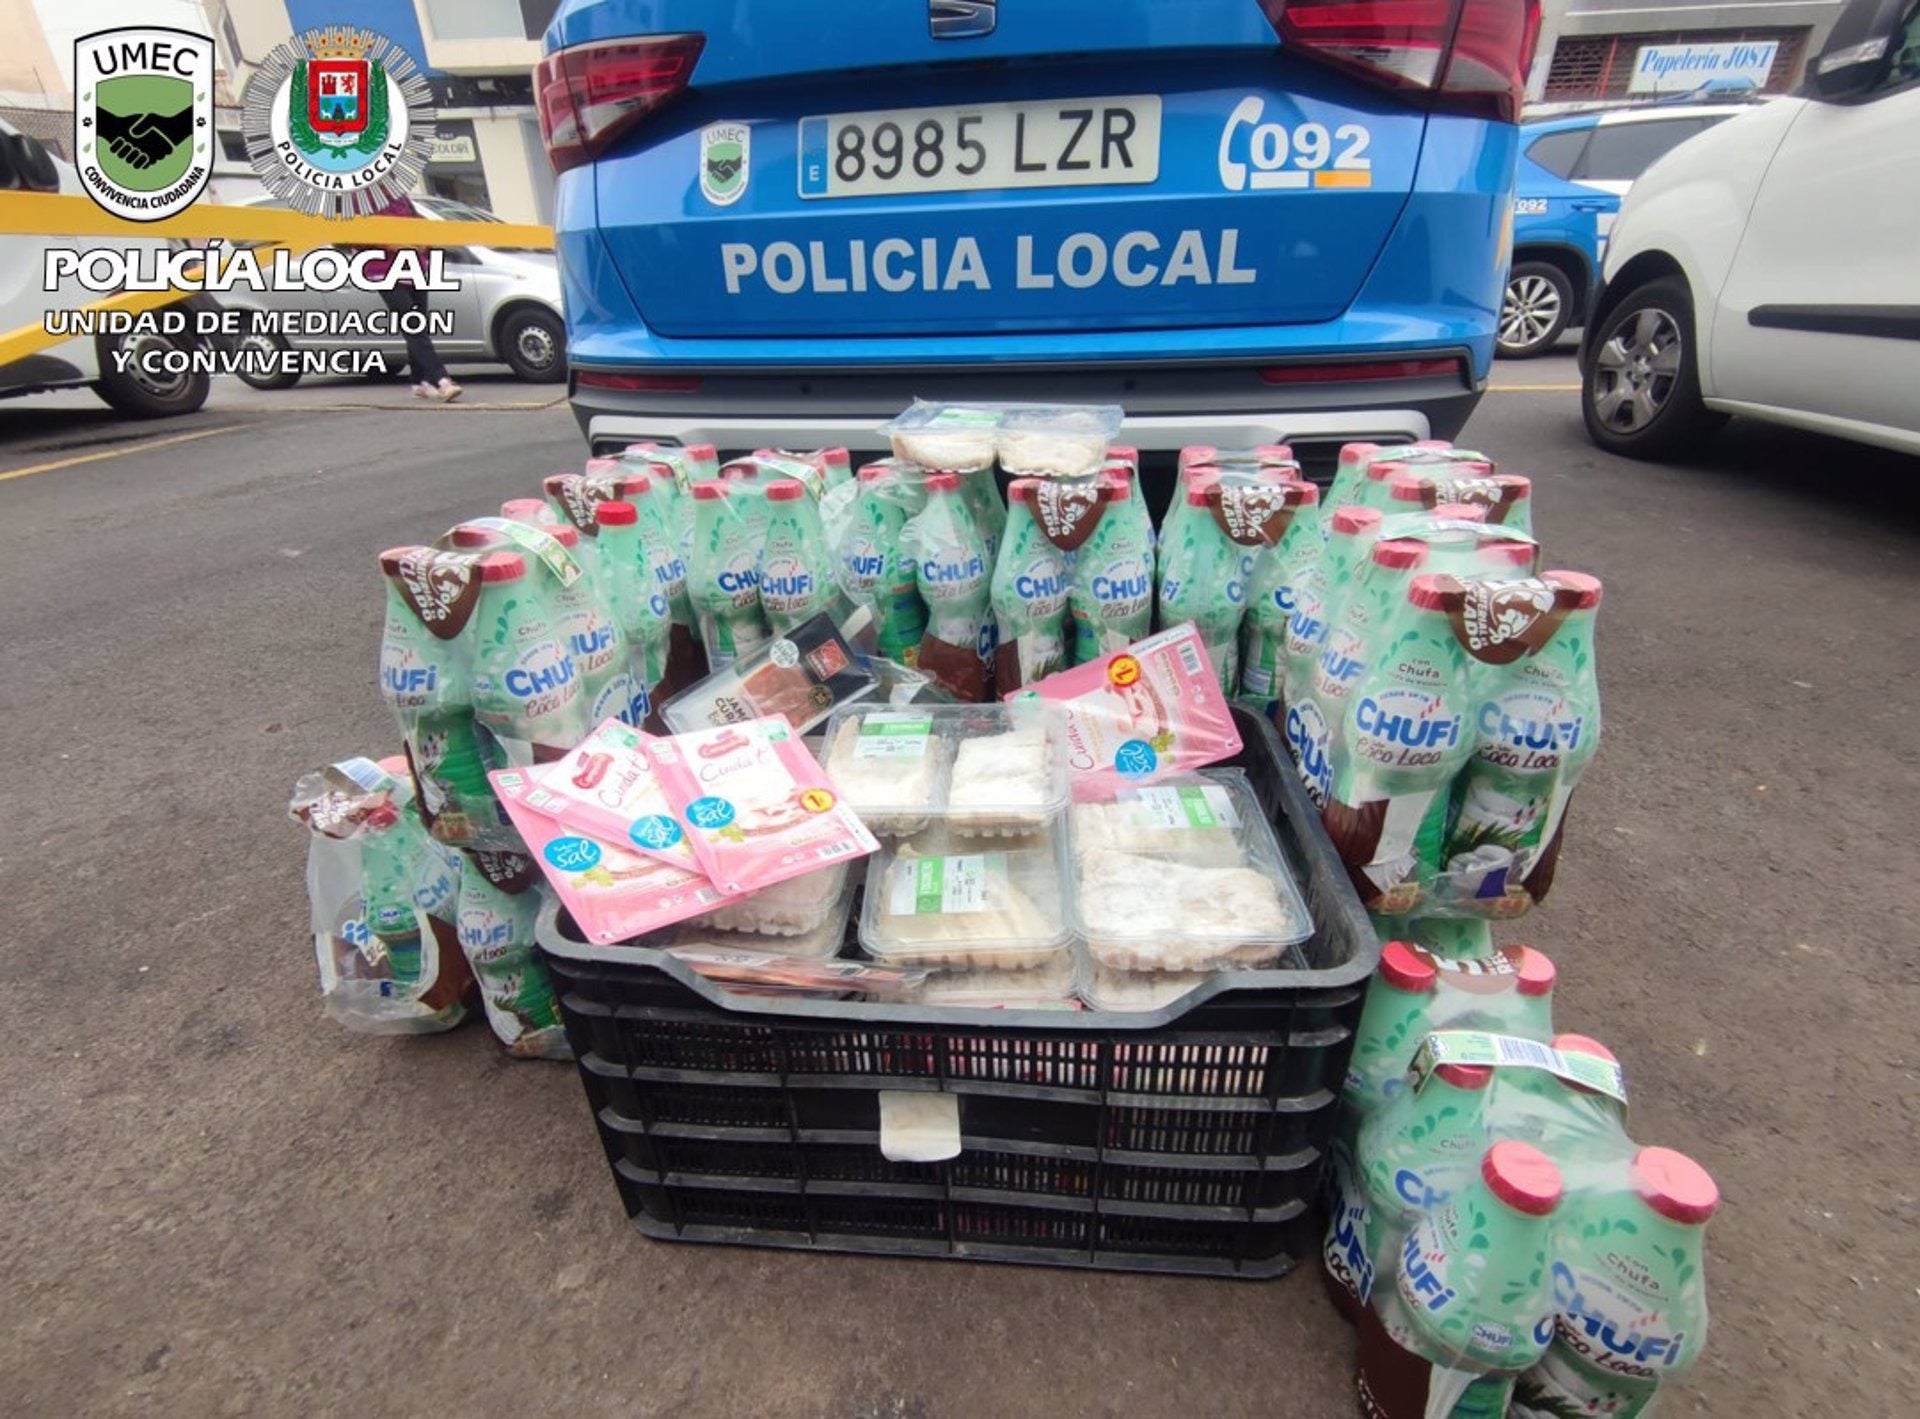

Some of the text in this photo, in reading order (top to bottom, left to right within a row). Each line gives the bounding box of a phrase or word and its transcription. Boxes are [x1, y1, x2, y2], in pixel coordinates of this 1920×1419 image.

[706, 128, 746, 145] UMEC
[836, 107, 1137, 183] 8985 LZR
[1250, 122, 1372, 170] 092
[809, 165, 820, 182] E
[721, 228, 1257, 295] POLICIA LOCAL
[505, 655, 575, 698] CHUF
[1398, 663, 1441, 679] Chufa
[1356, 697, 1462, 748] CHUFi
[556, 839, 598, 868] sal
[1607, 1251, 1660, 1290] Chufa
